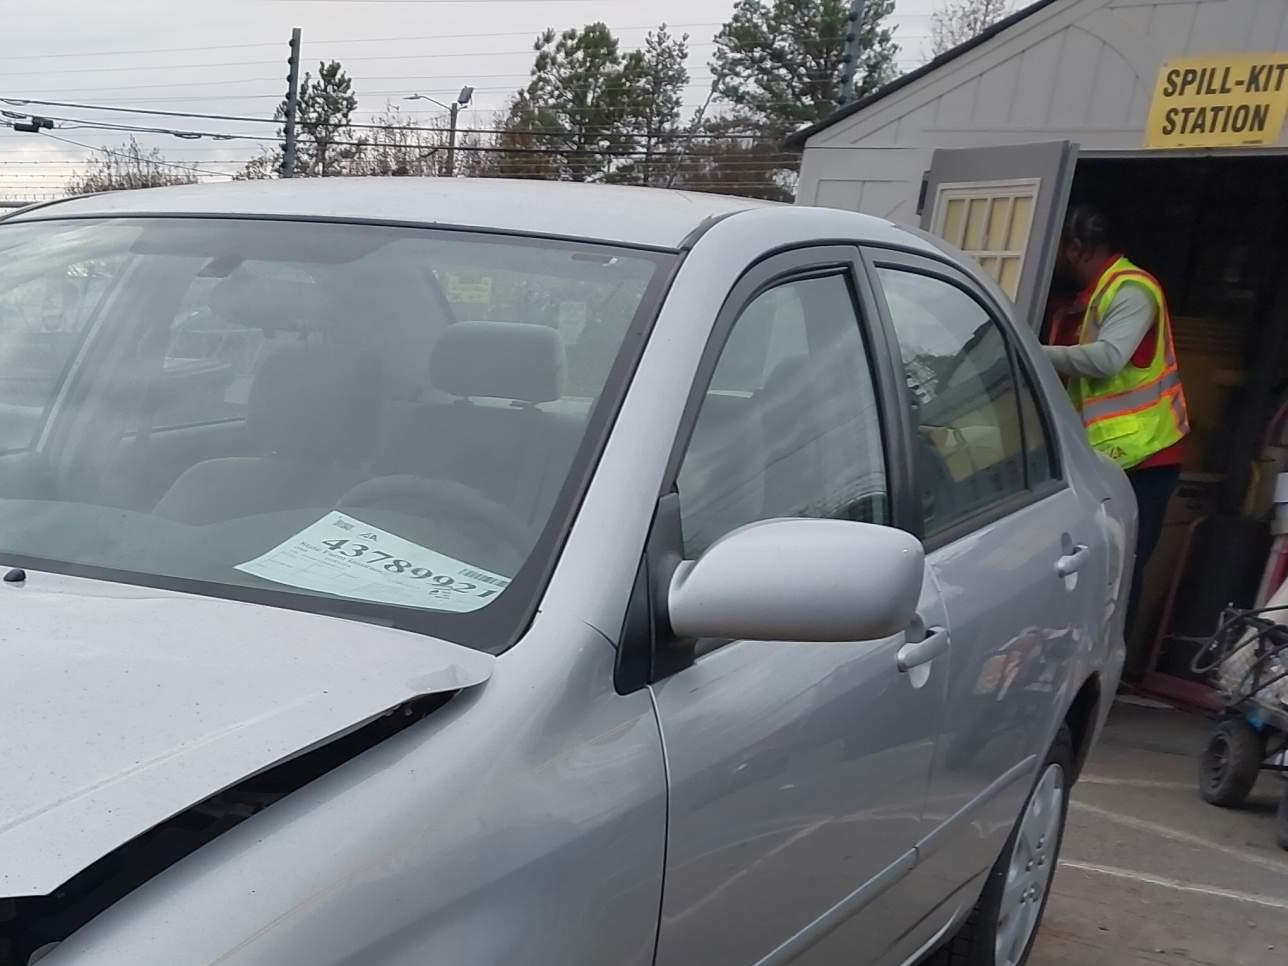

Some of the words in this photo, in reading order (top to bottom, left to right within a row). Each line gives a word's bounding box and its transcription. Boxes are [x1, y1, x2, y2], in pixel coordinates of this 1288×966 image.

[1162, 64, 1288, 97] SPILL-KIT
[1162, 104, 1270, 135] STATION
[321, 539, 497, 598] 43789921
